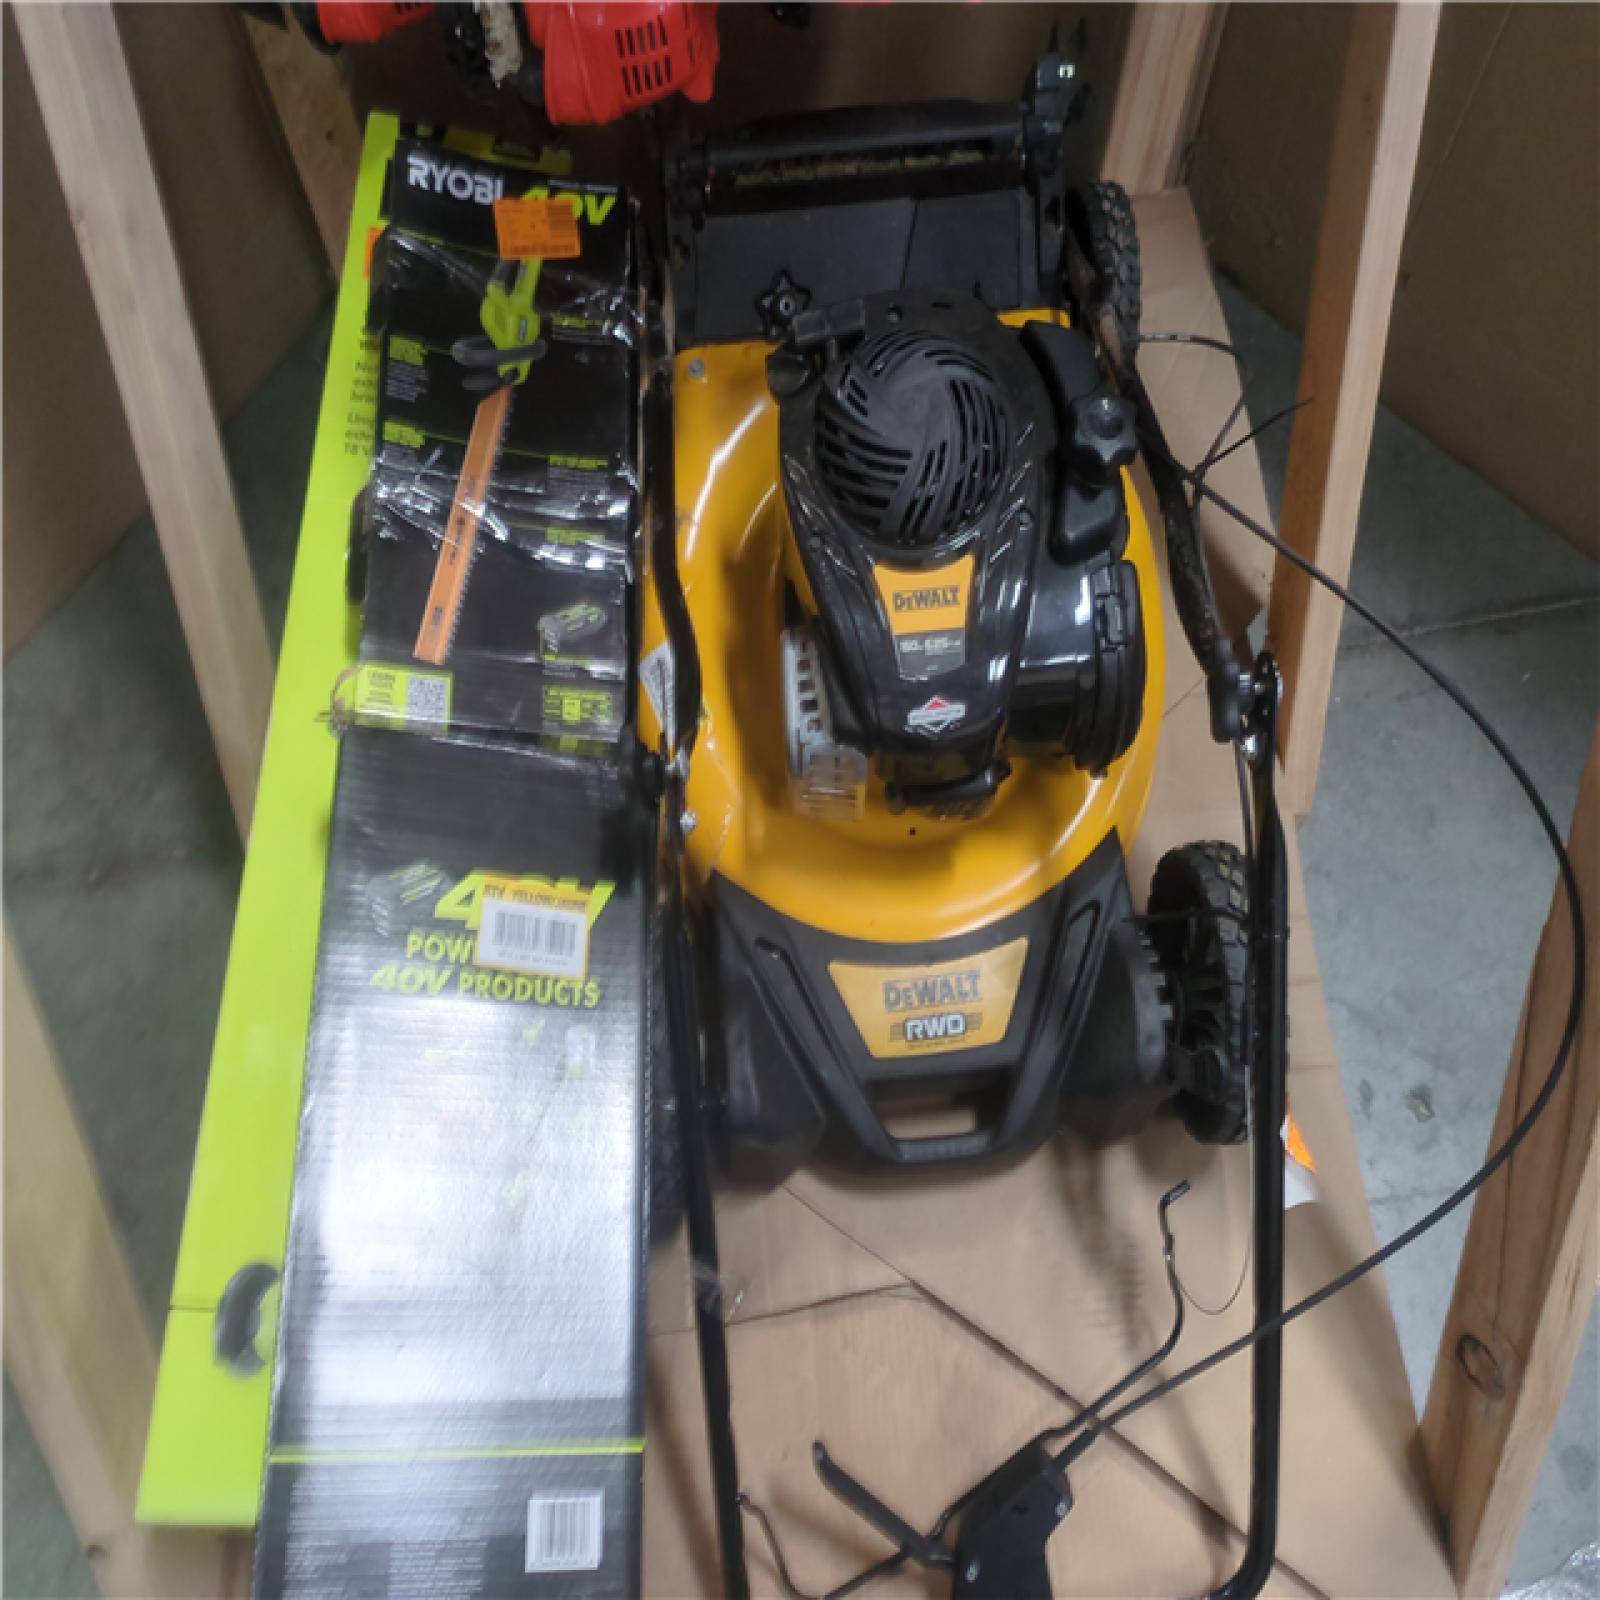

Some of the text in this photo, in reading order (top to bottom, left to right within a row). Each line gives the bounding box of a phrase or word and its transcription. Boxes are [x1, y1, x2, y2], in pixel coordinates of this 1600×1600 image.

[407, 154, 503, 205] RYOBI
[370, 963, 600, 1007] 40V PRODUCTS
[904, 1012, 966, 1041] RWD
